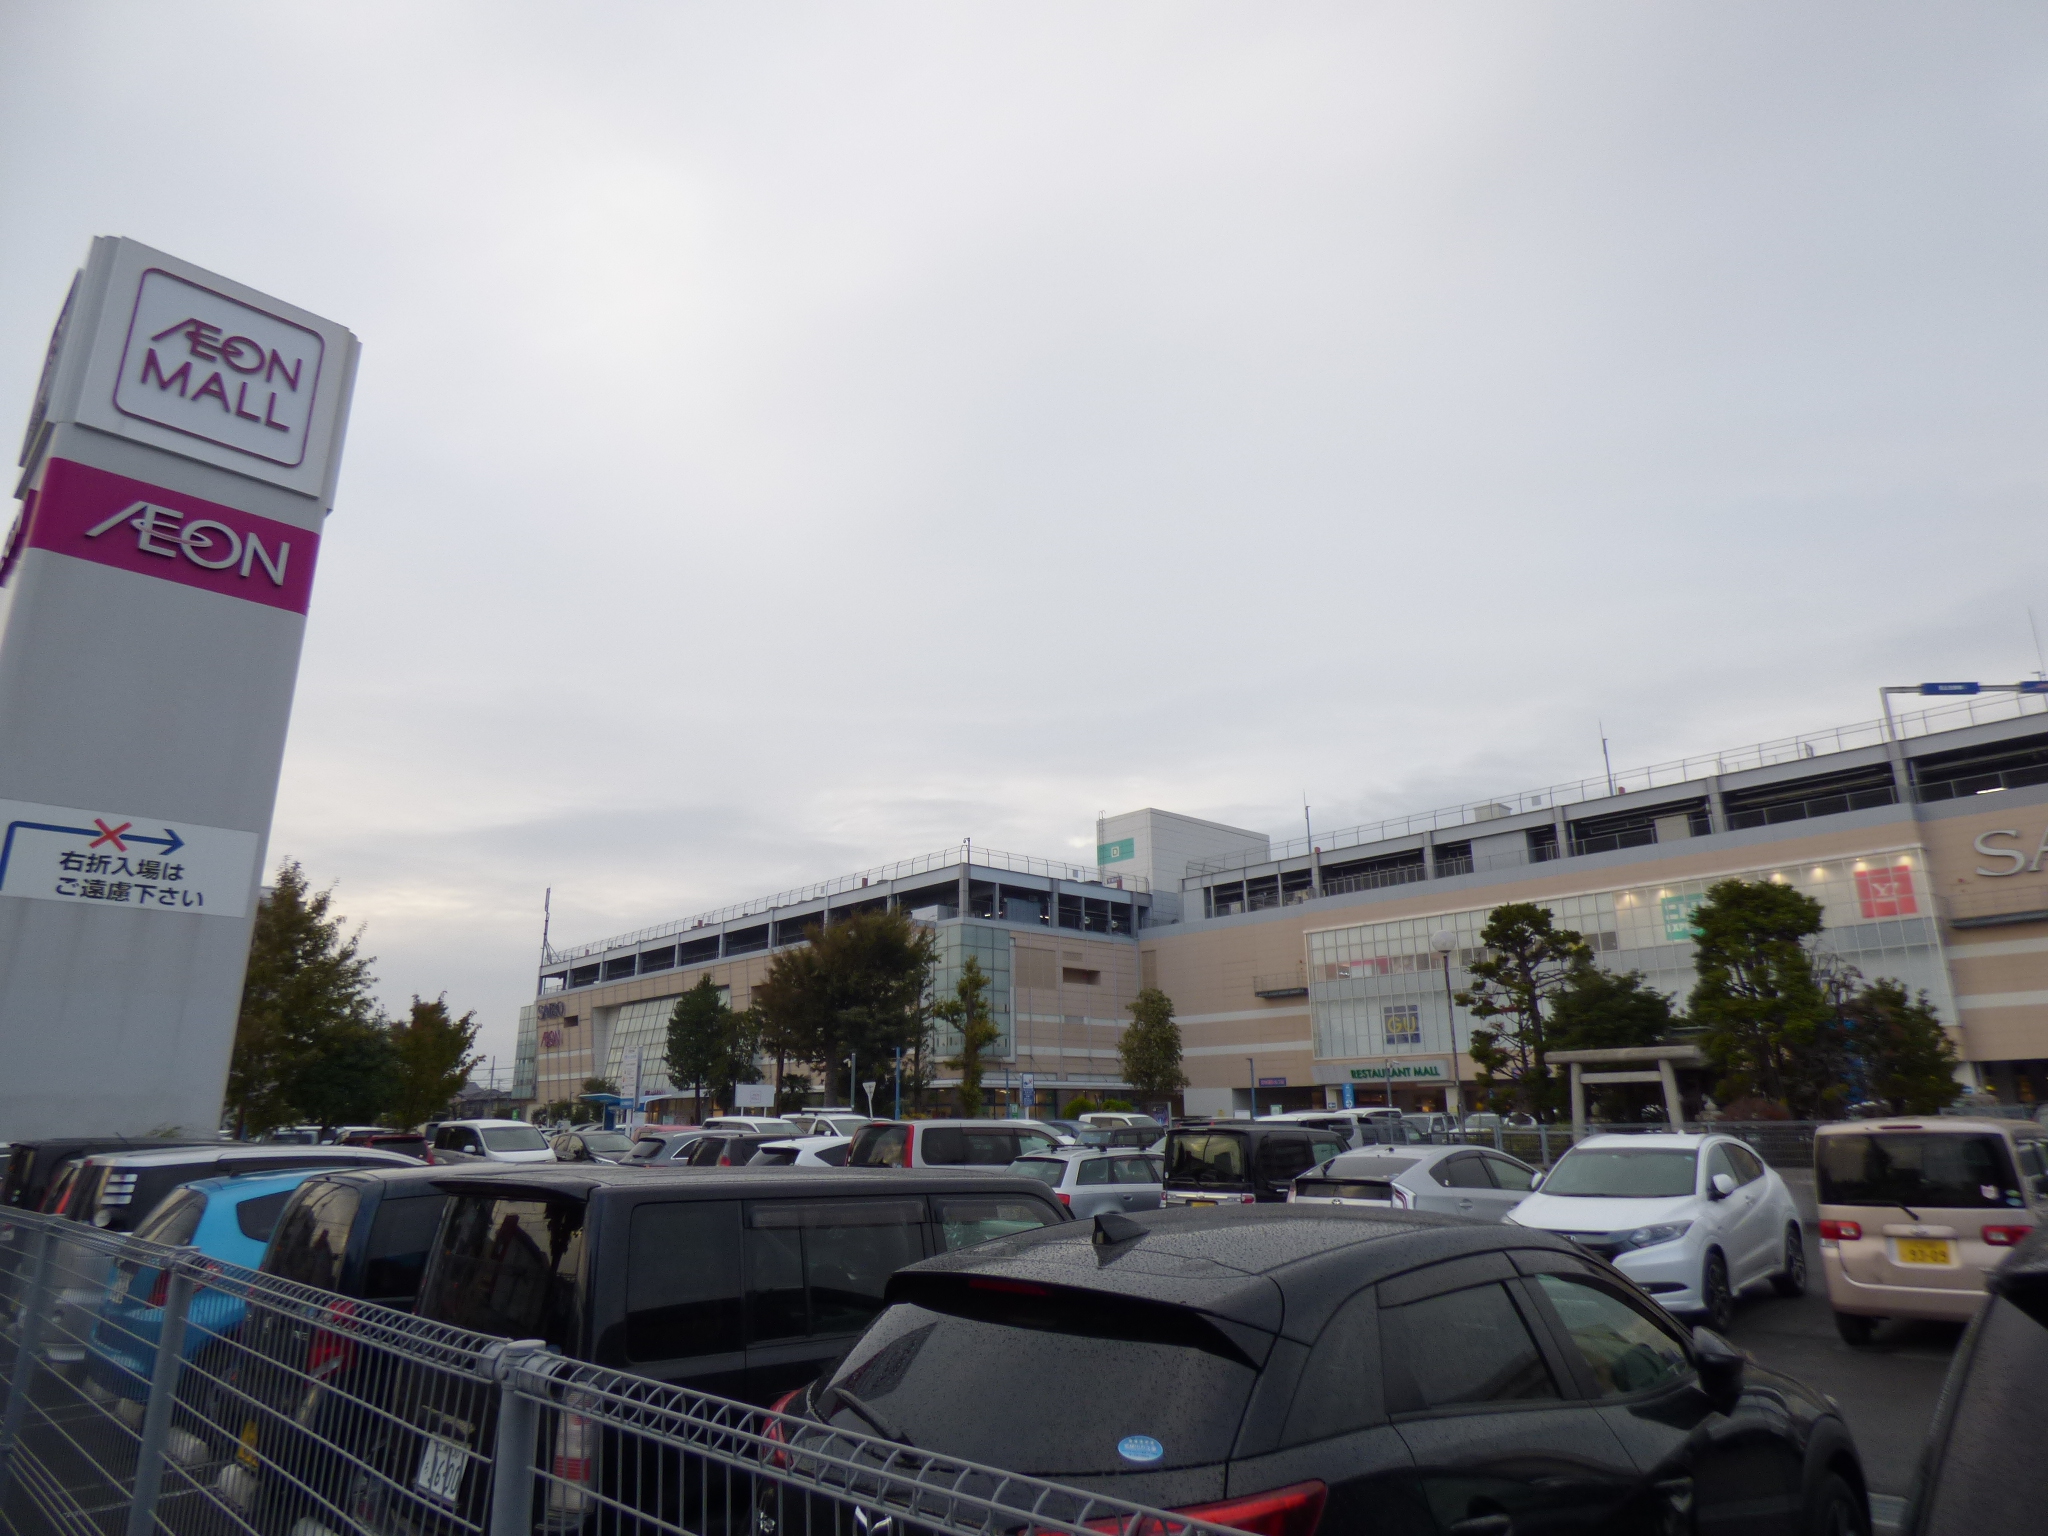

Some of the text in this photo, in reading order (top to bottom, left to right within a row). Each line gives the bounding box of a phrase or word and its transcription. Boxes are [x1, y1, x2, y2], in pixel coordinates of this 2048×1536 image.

[140, 347, 291, 433] MALL
[1111, 847, 1120, 858] D
[59, 851, 186, 882] 右折入場は
[55, 877, 204, 908] ご遠慮下さい
[1387, 1016, 1417, 1034] GU
[1413, 1066, 1440, 1077] MALL
